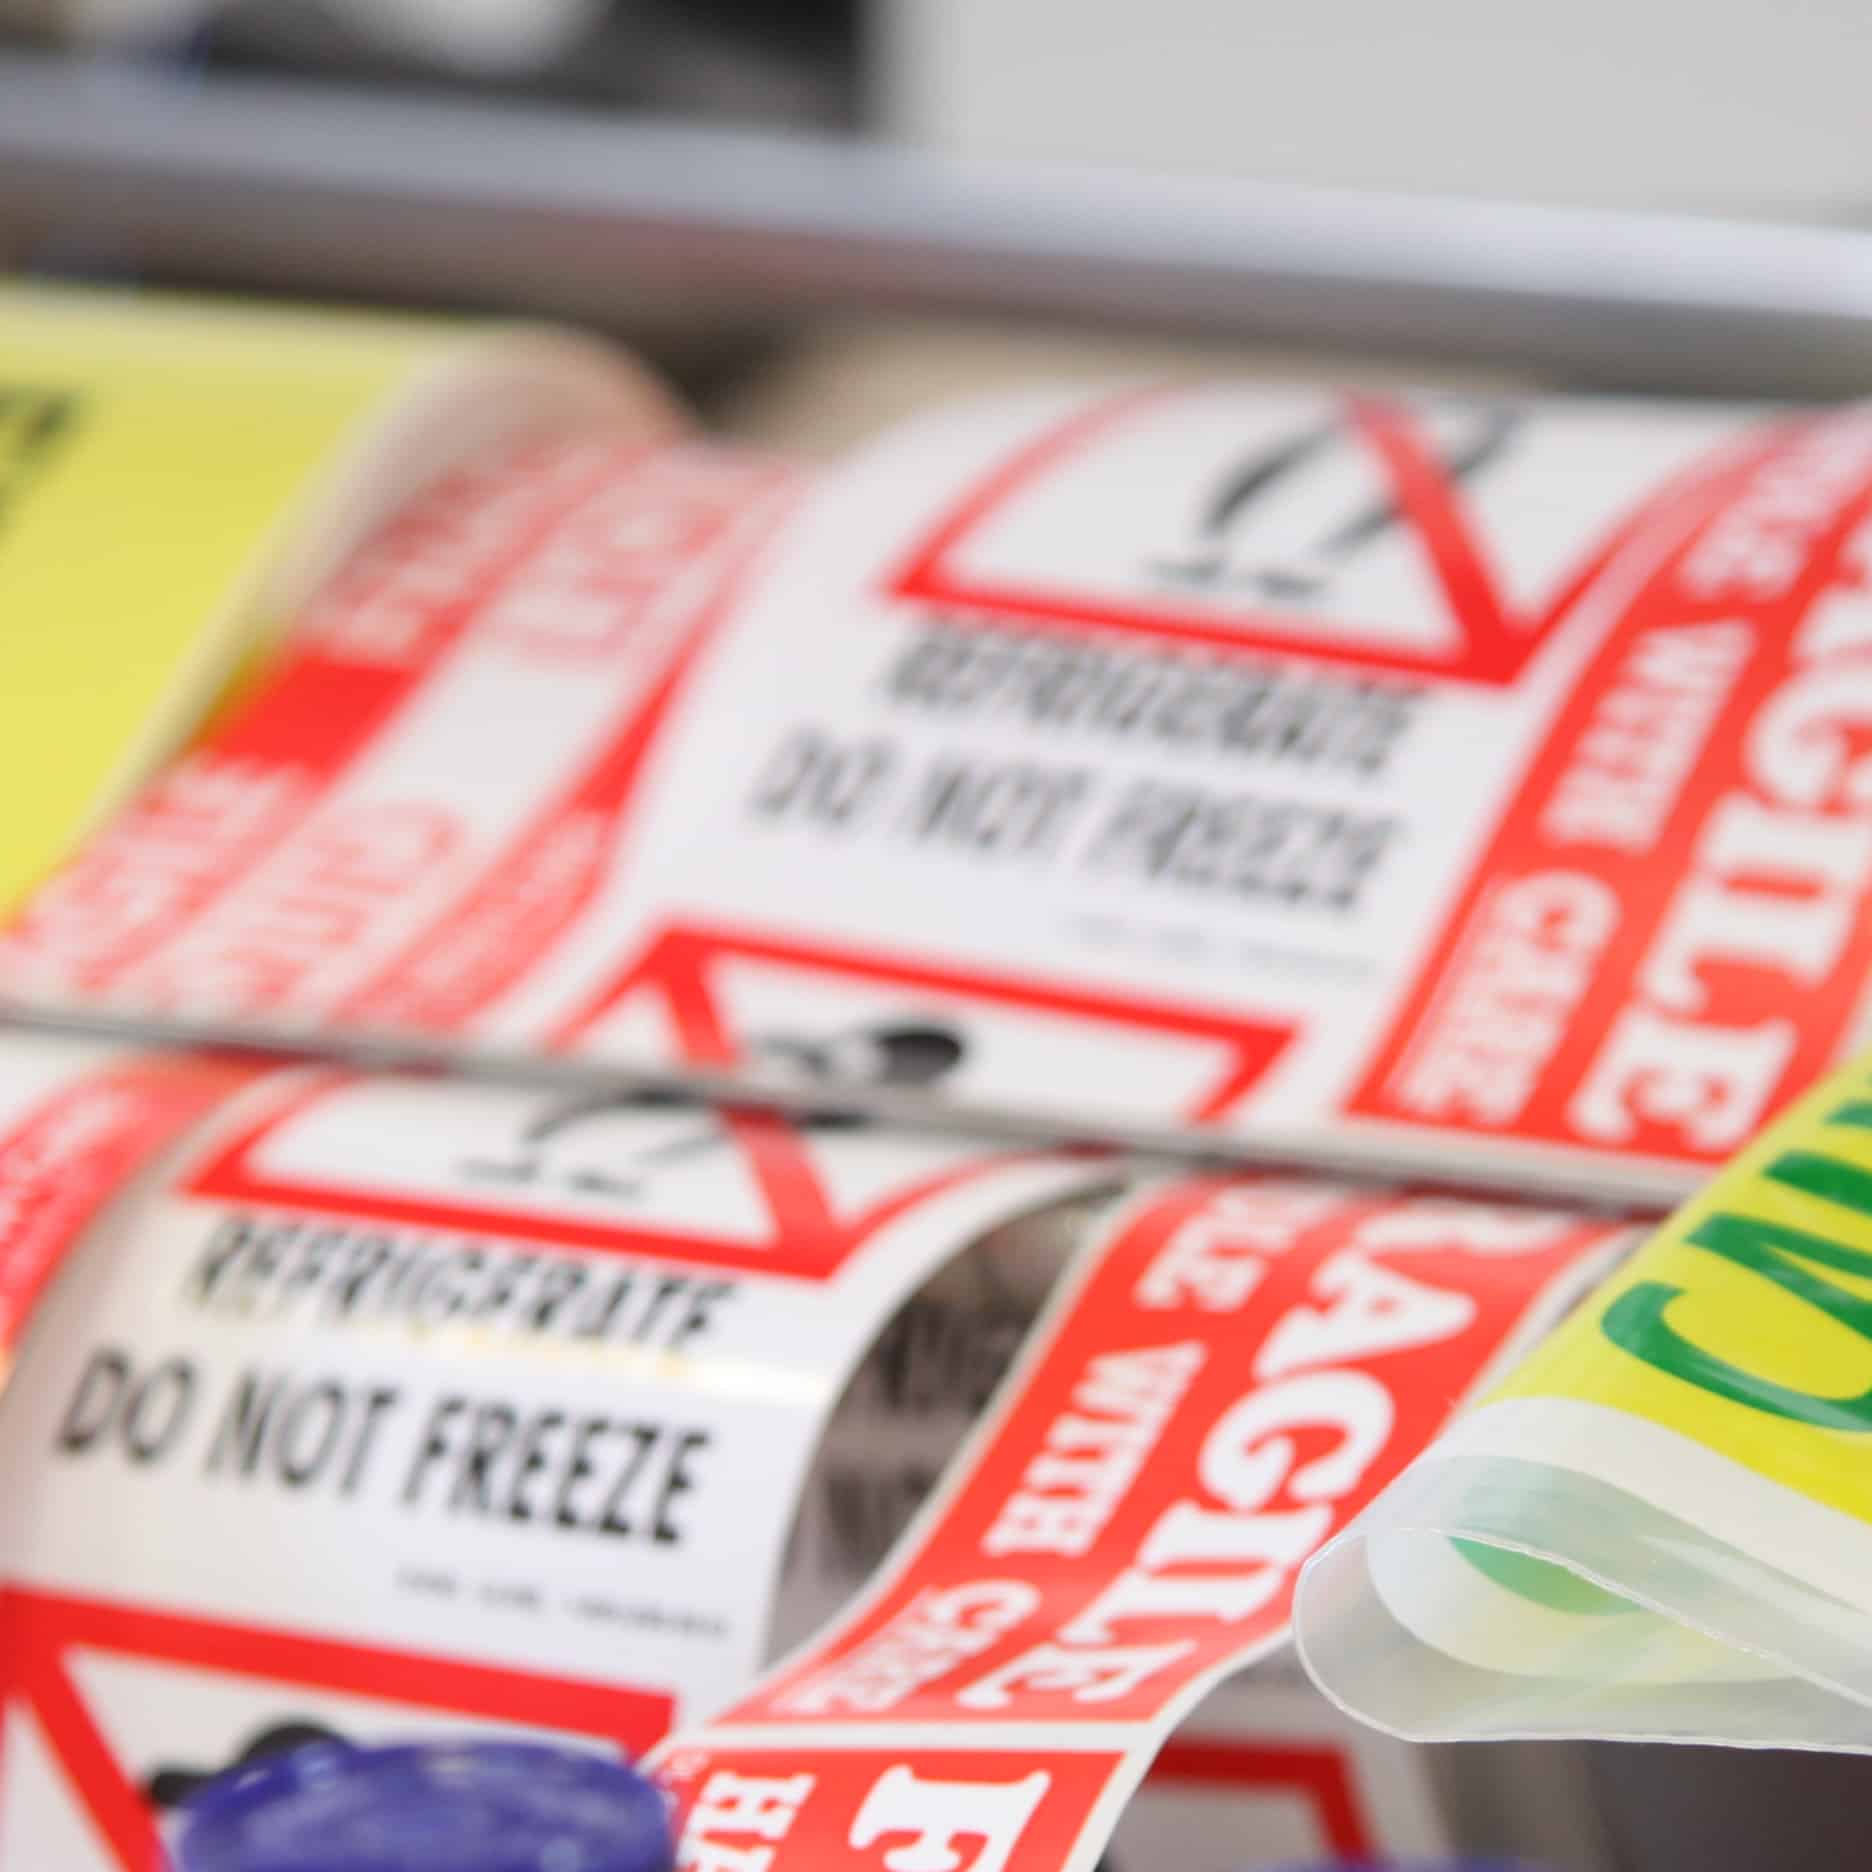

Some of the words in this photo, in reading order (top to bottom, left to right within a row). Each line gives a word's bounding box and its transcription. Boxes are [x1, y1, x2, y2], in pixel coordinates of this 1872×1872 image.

[57, 1345, 194, 1461] DO
[207, 1368, 396, 1504] NOT
[396, 1390, 717, 1551] FREEZE
[959, 1210, 1568, 1710] AGILE
[981, 1340, 1206, 1556] WITH
